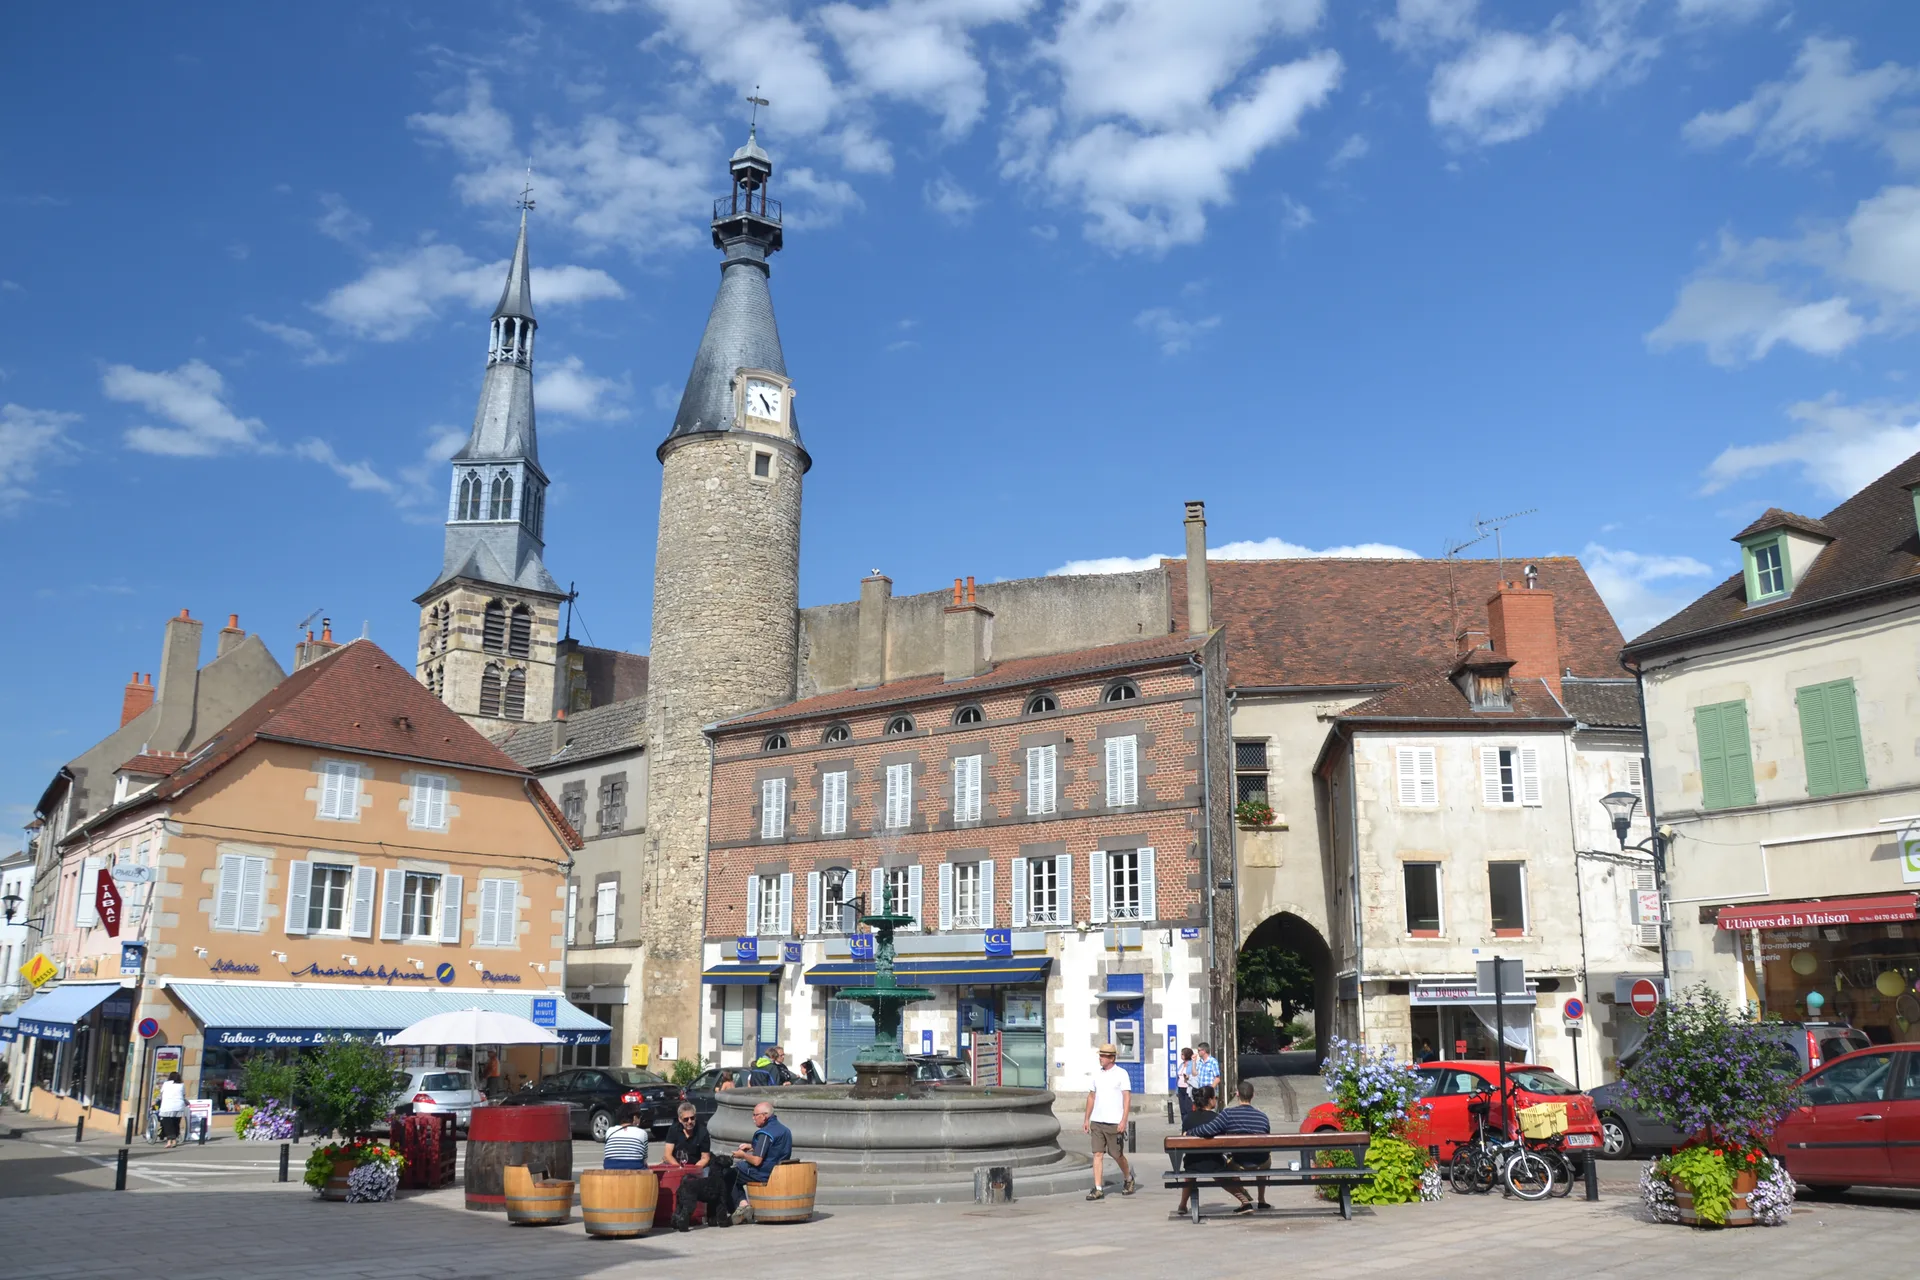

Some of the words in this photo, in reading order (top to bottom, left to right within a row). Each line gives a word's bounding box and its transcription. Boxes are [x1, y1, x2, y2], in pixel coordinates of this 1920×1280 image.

[101, 884, 116, 923] TABAC
[1725, 917, 1775, 929] L'Univers
[1777, 915, 1791, 926] de
[1792, 914, 1804, 925] la
[1805, 912, 1850, 924] Maison
[851, 938, 870, 947] LCL
[985, 934, 1008, 944] LCL
[737, 941, 755, 950] LCL
[784, 946, 799, 954] LCL
[33, 967, 55, 986] PRESSE
[1435, 986, 1469, 999] Bougies
[219, 1032, 256, 1044] Tabac
[265, 1033, 302, 1044] Presse
